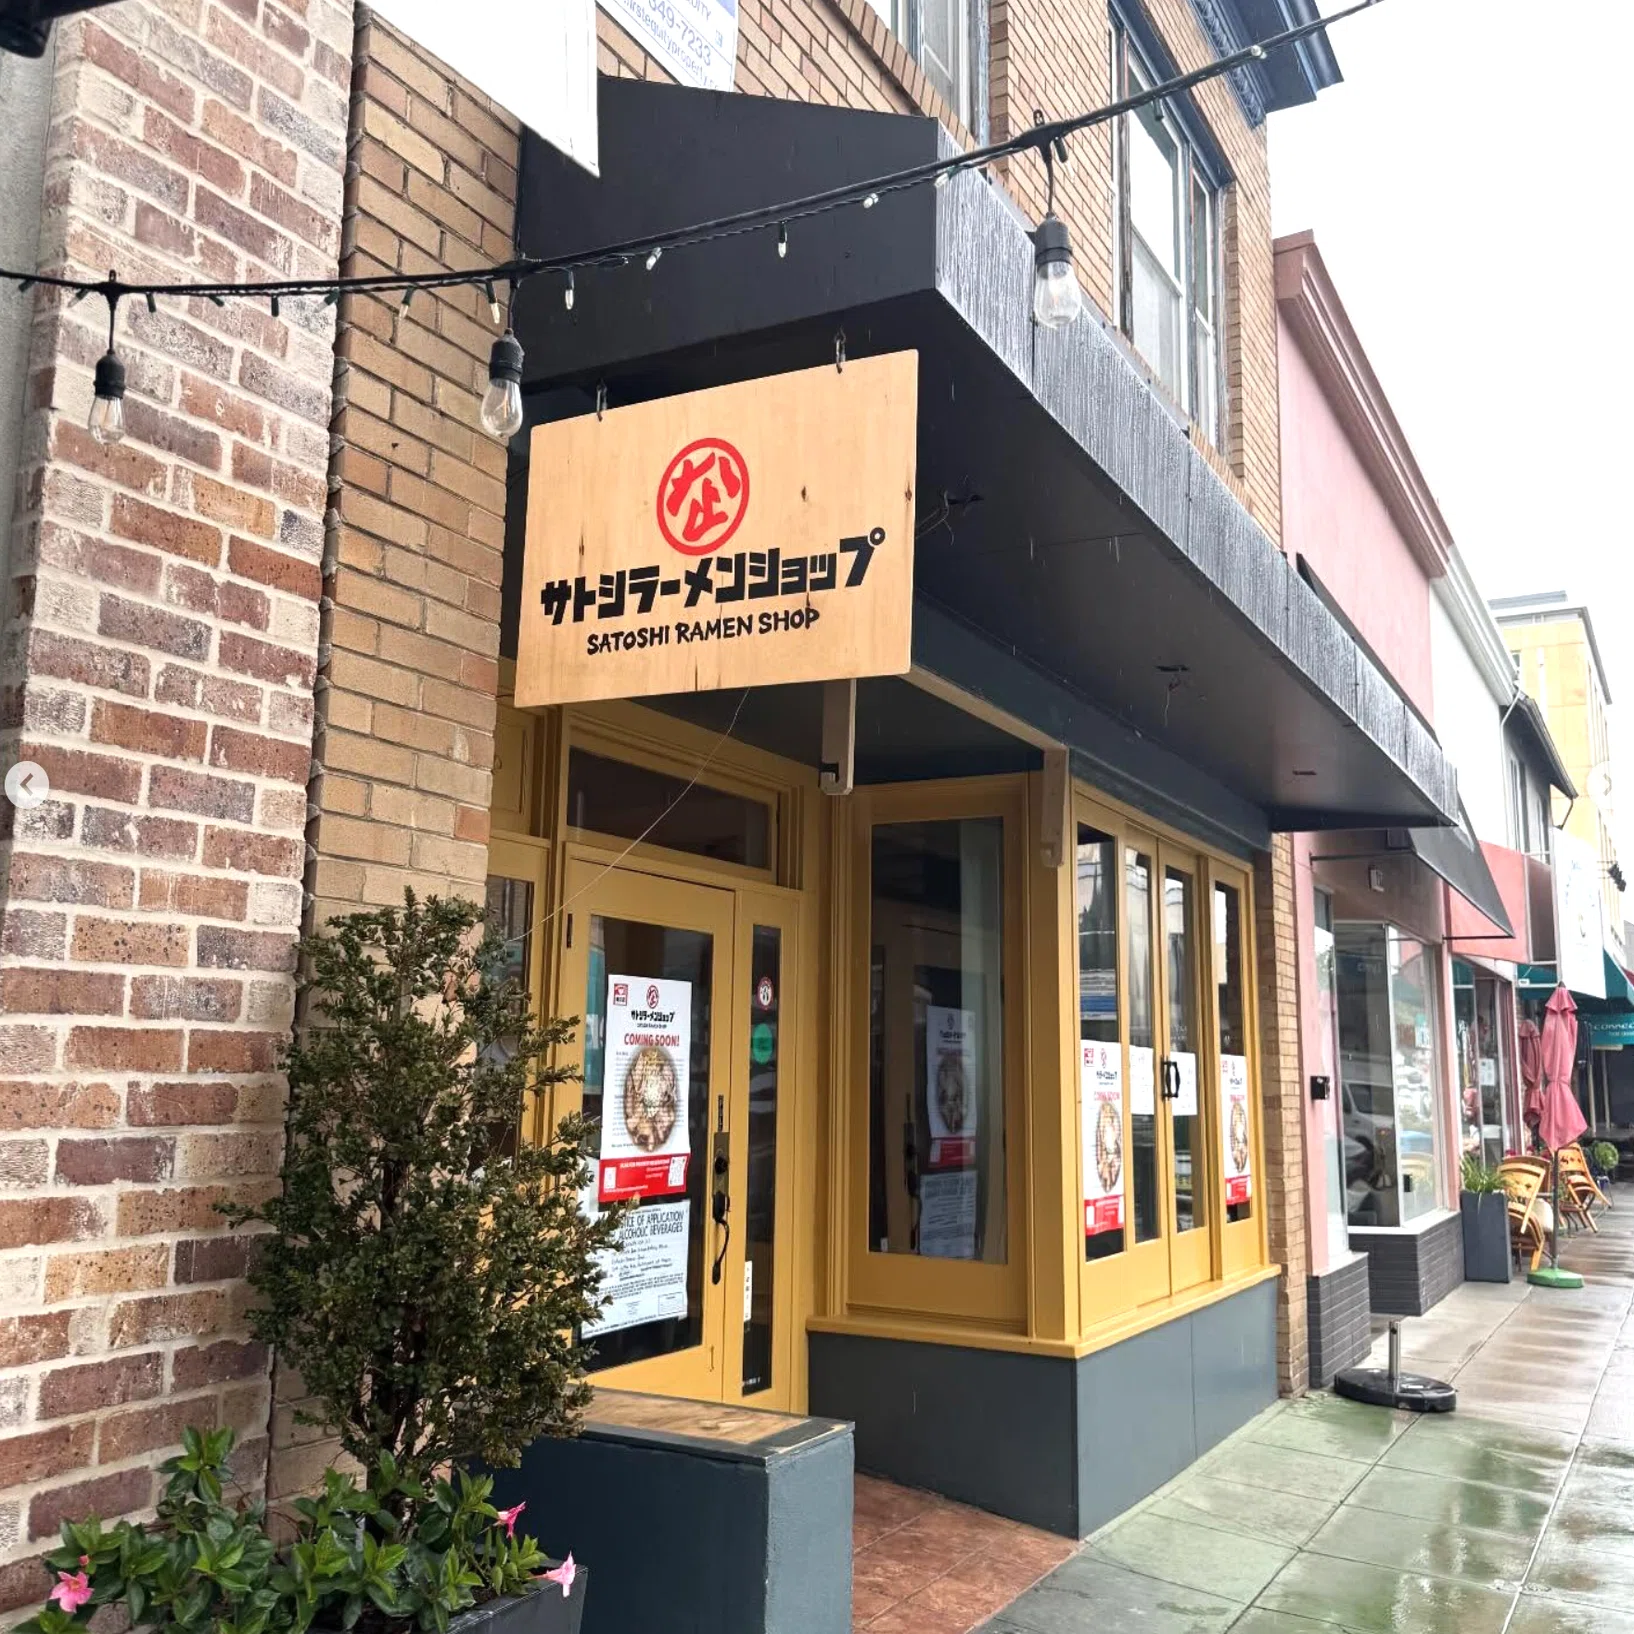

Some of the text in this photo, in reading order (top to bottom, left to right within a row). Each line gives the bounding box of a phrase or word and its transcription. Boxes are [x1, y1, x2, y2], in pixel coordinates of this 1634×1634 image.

[540, 527, 886, 626] サトシラーメンショップ
[587, 607, 820, 655] SATOSHI RAMEN SHOP
[624, 1033, 680, 1047] COMING SOON!
[646, 1211, 685, 1225] APPLICATION
